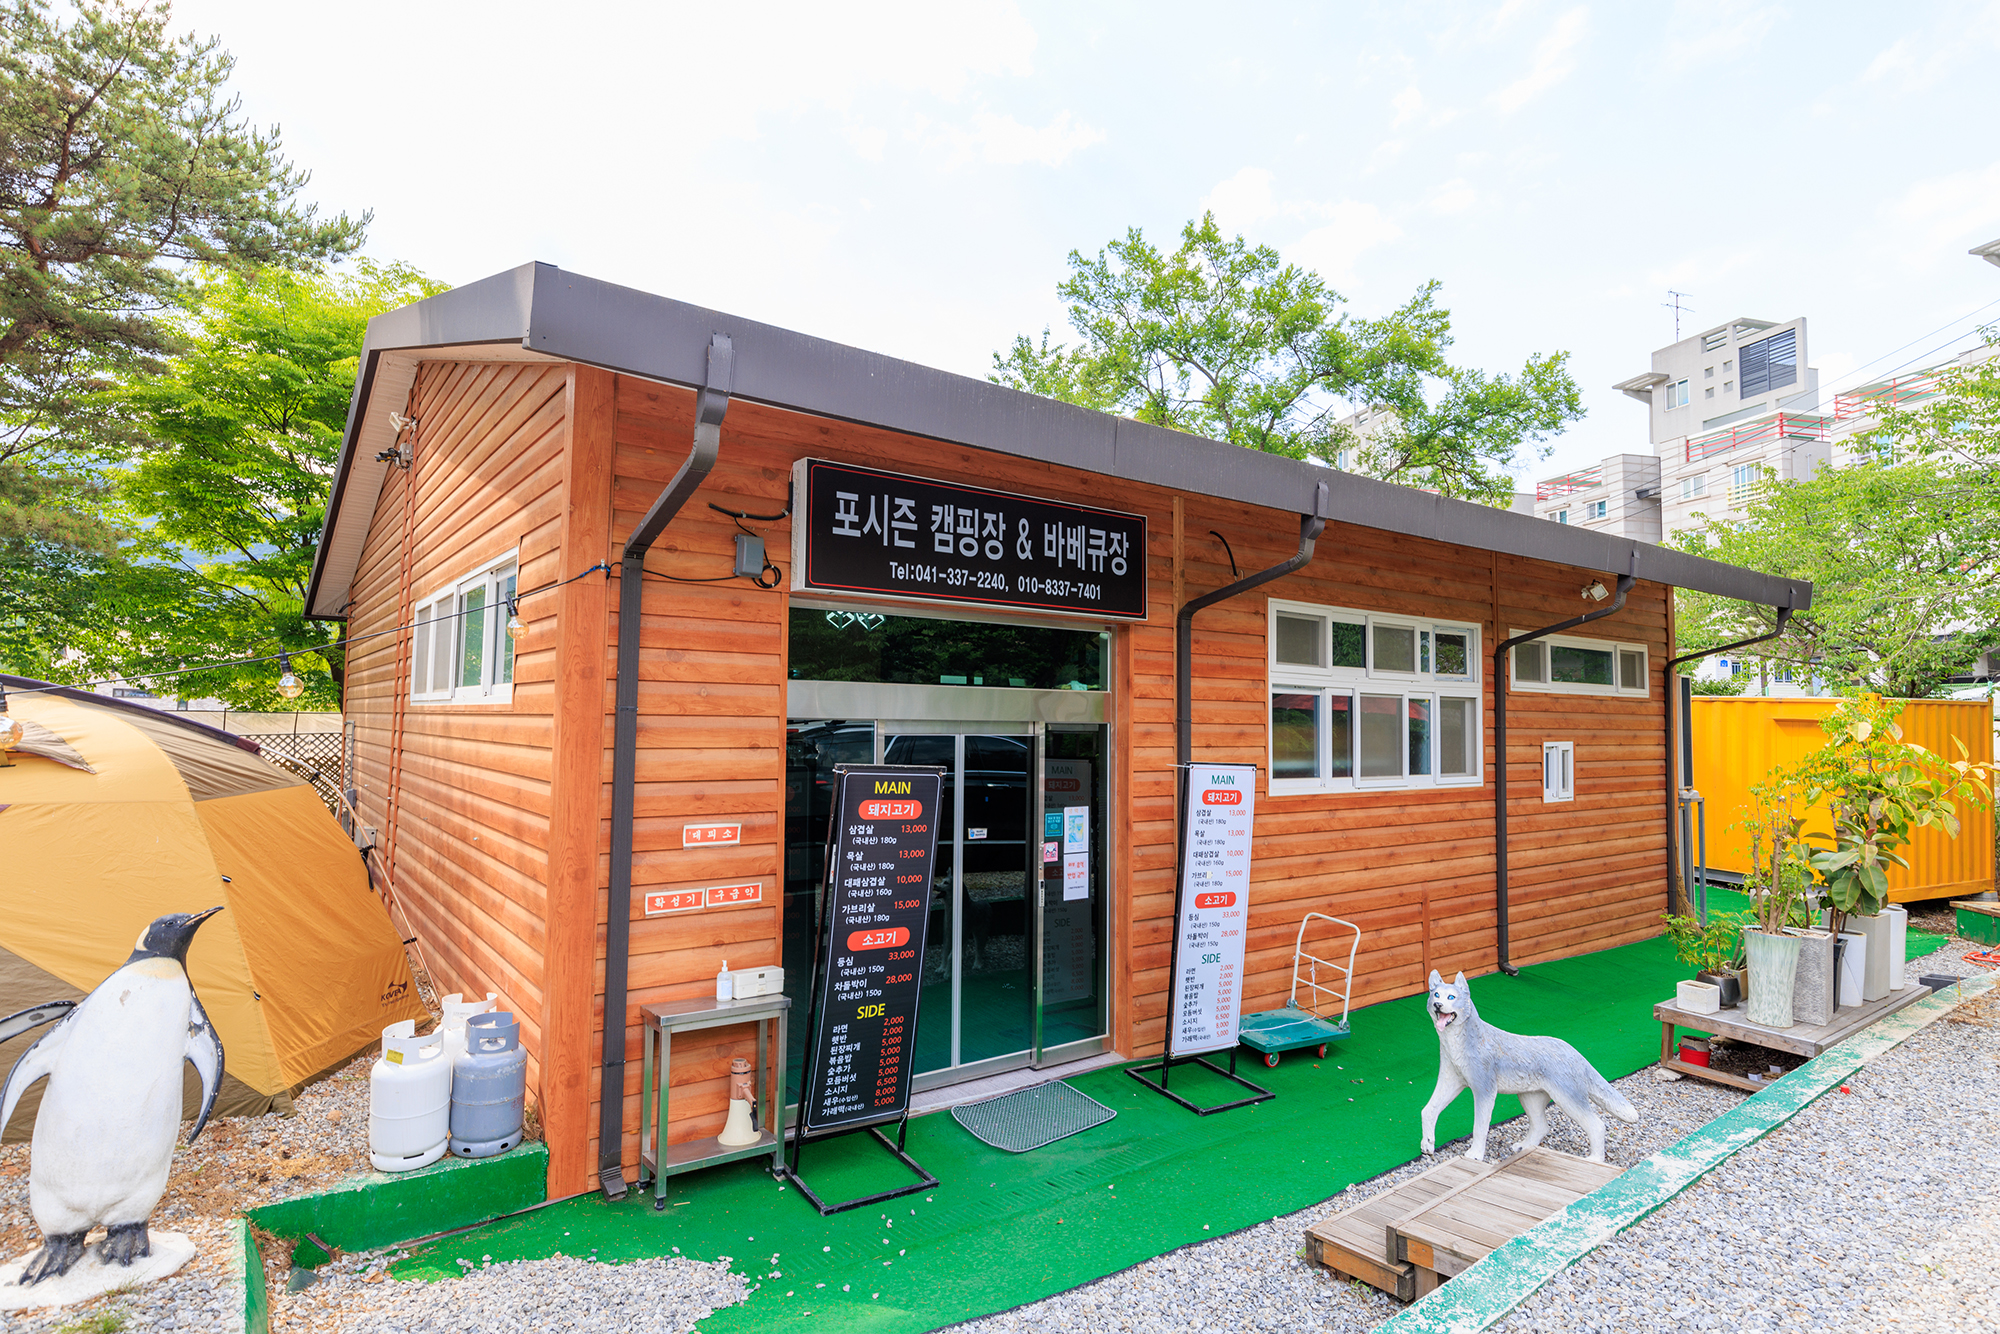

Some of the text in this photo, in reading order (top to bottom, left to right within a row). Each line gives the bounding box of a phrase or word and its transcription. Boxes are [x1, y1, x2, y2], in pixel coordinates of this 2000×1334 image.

[832, 490, 1129, 576] 포시즌 캠핑장 & 바베큐장
[889, 561, 1102, 600] Tel:041-337-2240, 010-8337-7401
[1052, 766, 1072, 775] MAIN
[1048, 781, 1076, 789] 돼지고기
[1211, 775, 1235, 784] MAIN
[874, 781, 911, 794] MAIN
[1207, 792, 1237, 803] 돼지고기
[868, 803, 914, 817] 돼지고기
[1229, 809, 1246, 817] 13,000
[692, 829, 732, 841] 대피소
[849, 825, 927, 834] 삼겹살 13,000
[852, 837, 897, 845] (국내산) 180g
[846, 850, 925, 861] 목살 13,000
[850, 863, 876, 871] (국내산)
[1192, 871, 1213, 879] 가브리
[844, 874, 922, 888] 대패삼겹살 10,000
[715, 886, 754, 900] 구급약
[848, 889, 873, 898] (국내산)
[1204, 894, 1228, 905] 소고기
[842, 900, 920, 914] 가브리살 15,000
[846, 914, 890, 924] (국내산) 180g
[1222, 910, 1241, 918] 33,000
[862, 931, 896, 946] 소고기
[837, 950, 914, 967] 등심 33,000
[1201, 953, 1221, 965] SIDE
[840, 965, 884, 977] (국내산) 150g
[834, 973, 912, 991] 차돌박이 28,000
[1218, 980, 1232, 988] 5,000
[838, 989, 882, 1001] (국내산) 150g
[1218, 988, 1232, 996] 5,000
[856, 1003, 886, 1020] SIDE
[833, 1016, 904, 1034] 라면 2,000
[1216, 1021, 1229, 1029] 8,000
[832, 1026, 903, 1045] 햇반 2,000
[1216, 1029, 1229, 1038] 5,000
[830, 1036, 902, 1055] 된장찌개 5,000
[829, 1046, 900, 1065] 볶음밥 5,000
[879, 1056, 899, 1066] 5,000
[878, 1066, 898, 1076] 5,000
[824, 1076, 897, 1096] 소시지 6,500
[875, 1086, 896, 1097] 8,000
[874, 1096, 895, 1107] 5,000
